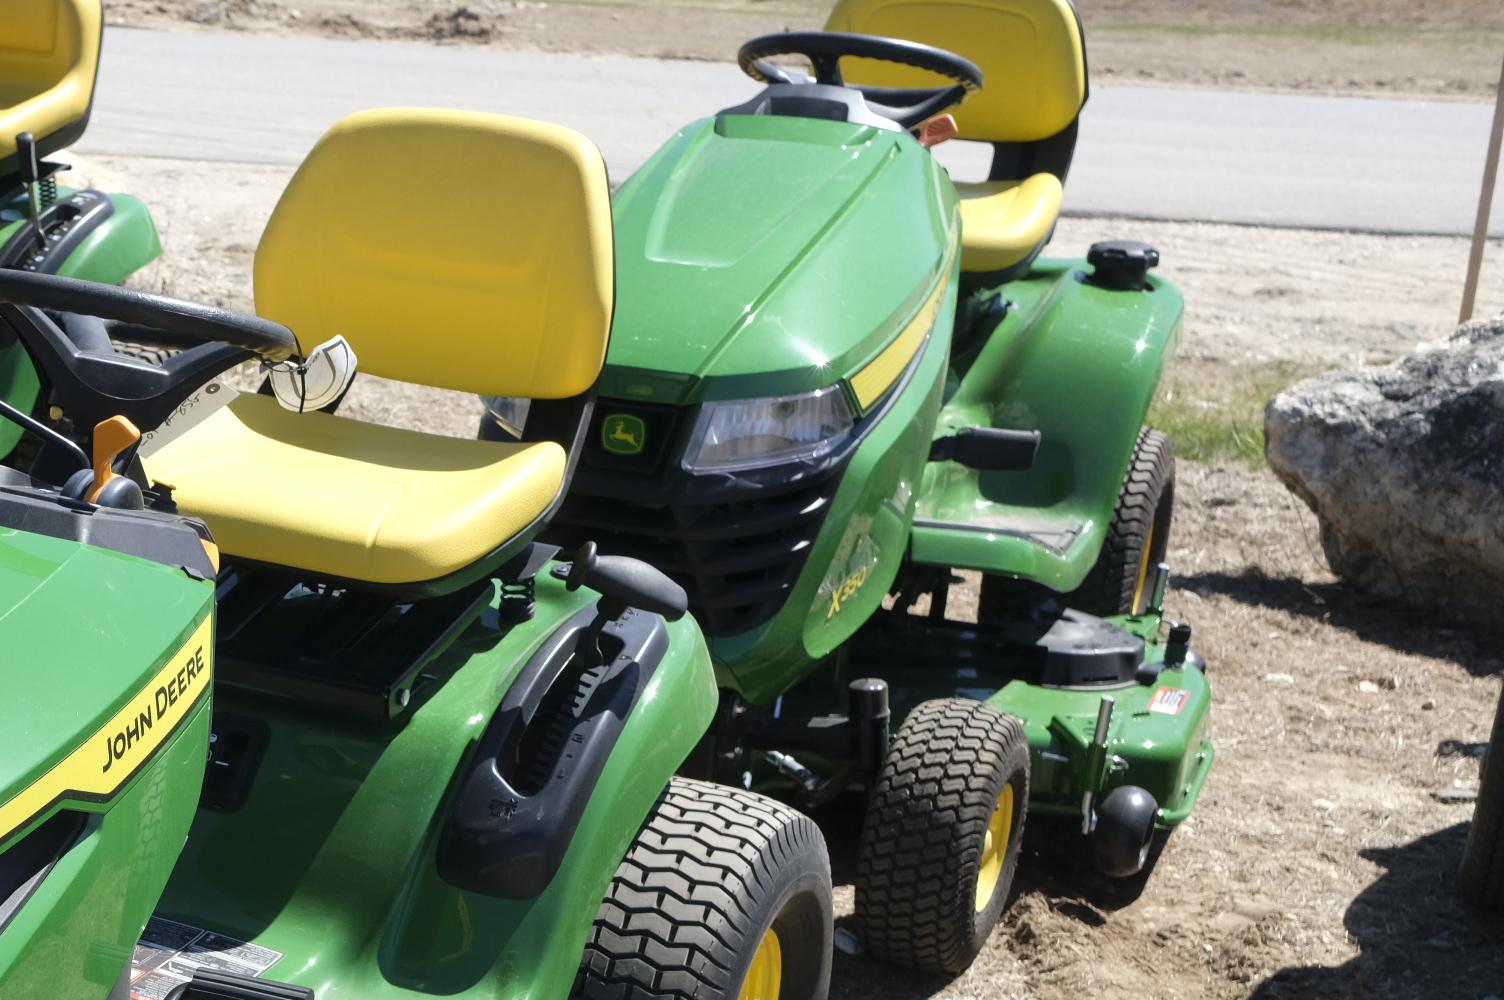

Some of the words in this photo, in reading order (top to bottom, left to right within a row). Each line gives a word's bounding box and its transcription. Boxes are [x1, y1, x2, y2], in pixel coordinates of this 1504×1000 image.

[827, 566, 867, 619] X350
[102, 703, 153, 774] JOHN
[154, 644, 205, 721] DEERE
